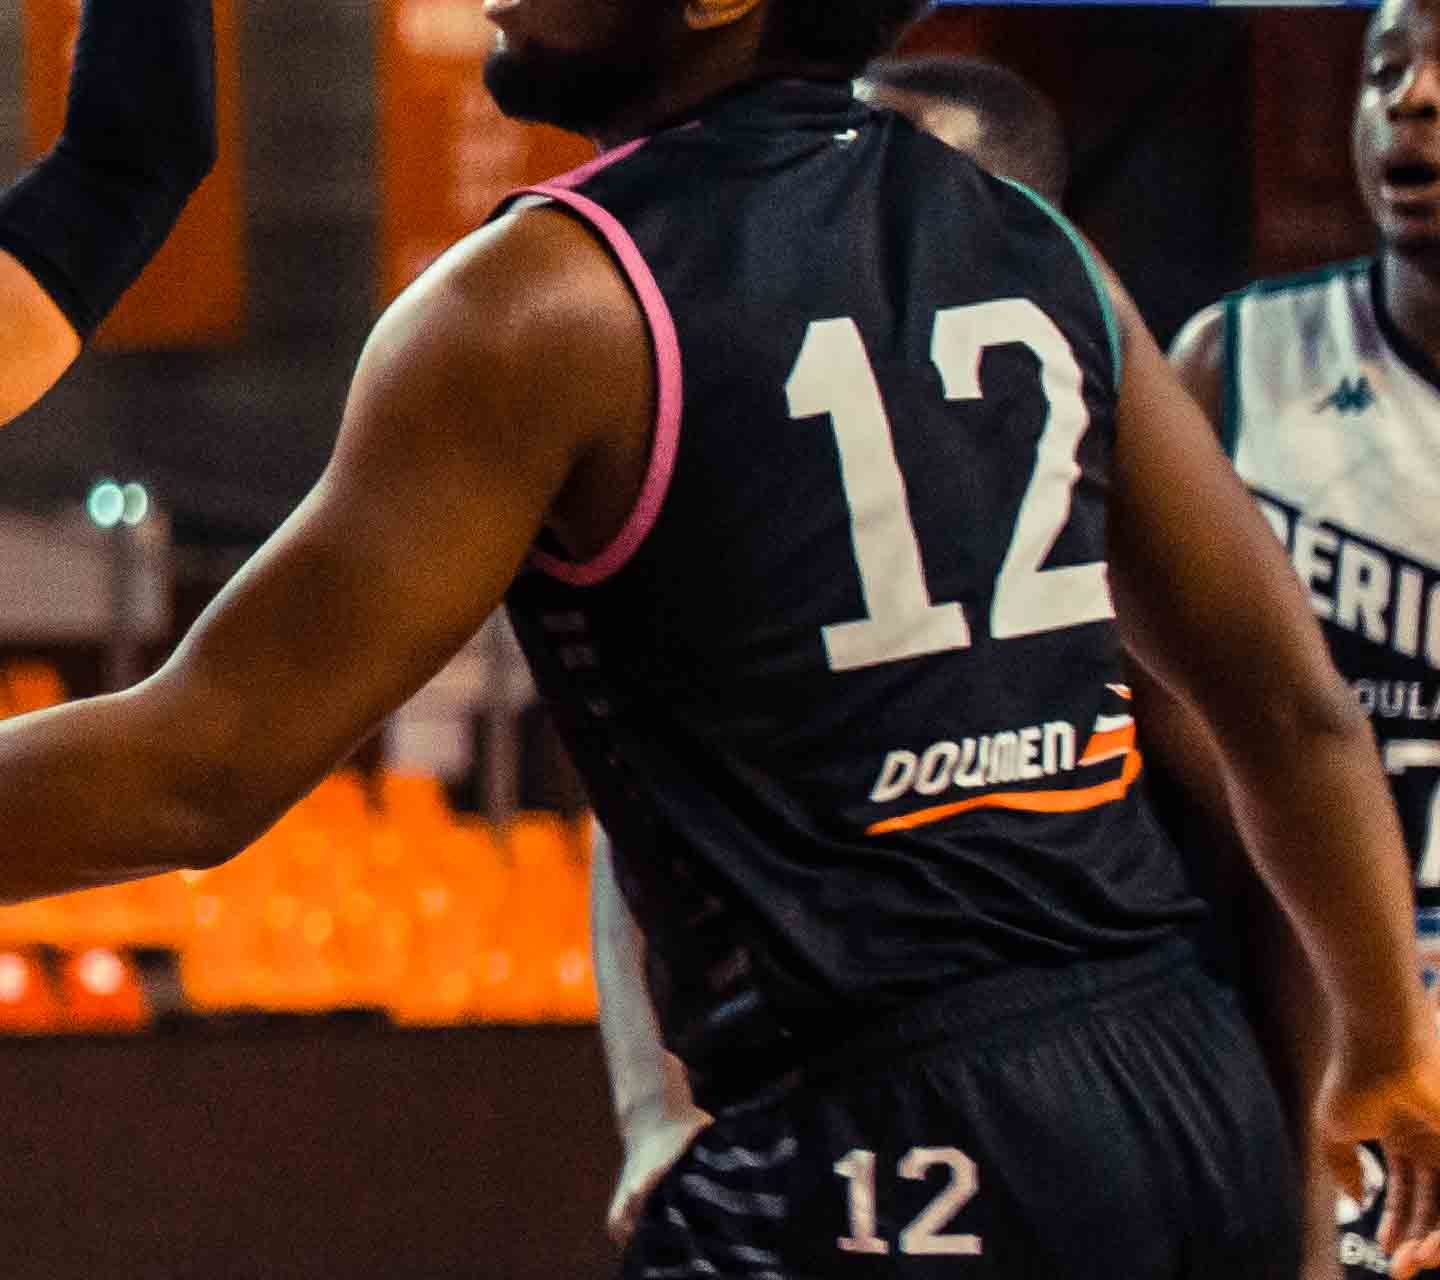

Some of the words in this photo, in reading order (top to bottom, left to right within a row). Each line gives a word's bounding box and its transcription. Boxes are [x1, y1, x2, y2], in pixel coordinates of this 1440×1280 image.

[784, 297, 1117, 672] 12
[1262, 504, 1440, 669] ERI
[868, 720, 1077, 803] DOUMEN
[832, 1145, 983, 1256] 12
